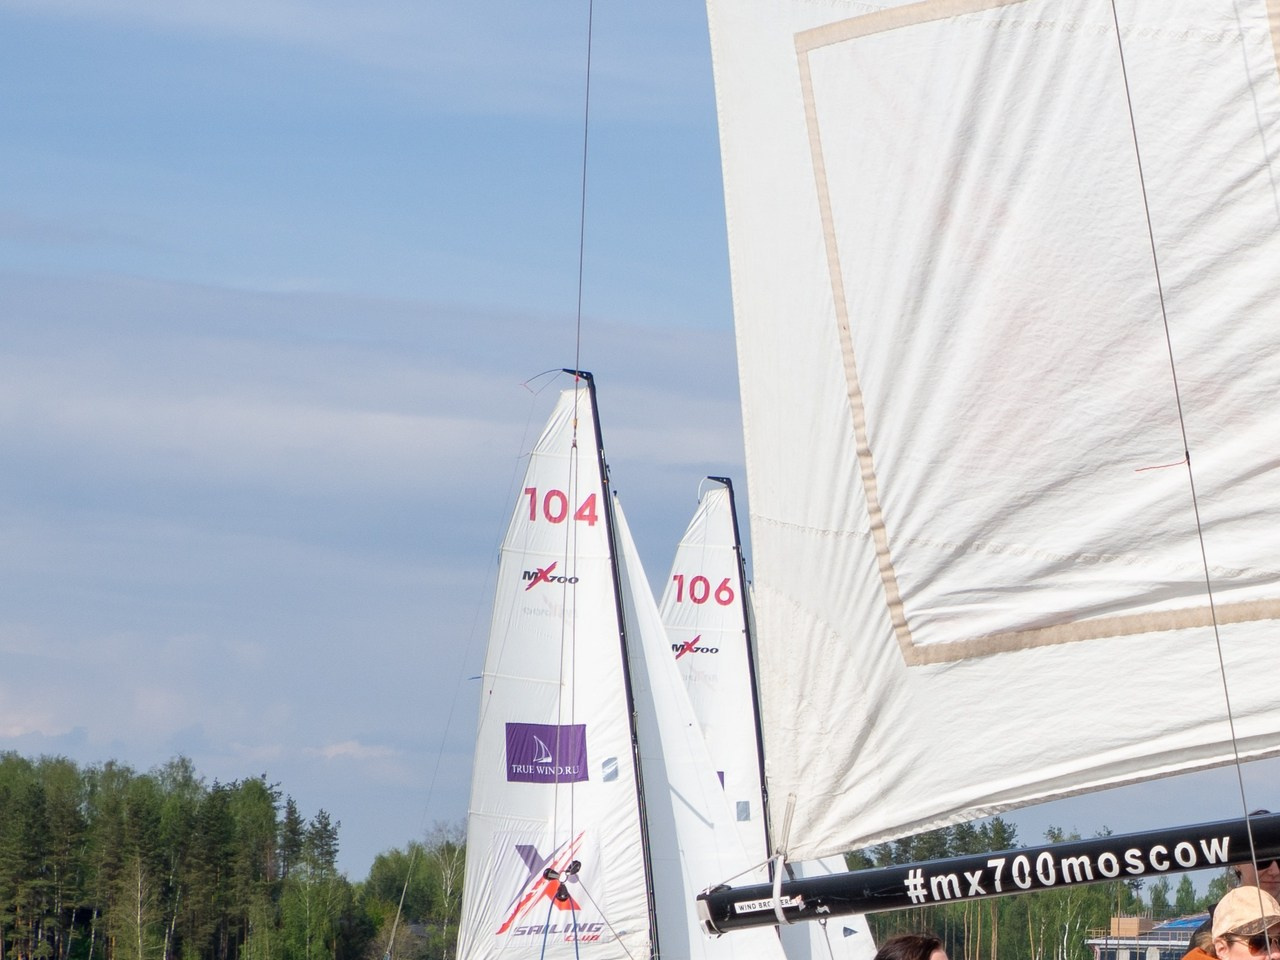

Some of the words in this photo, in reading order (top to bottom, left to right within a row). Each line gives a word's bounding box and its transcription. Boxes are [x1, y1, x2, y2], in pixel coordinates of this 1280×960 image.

[524, 487, 598, 527] 104
[672, 574, 735, 606] 106
[511, 764, 535, 774] TRUE
[536, 765, 580, 775] WIND.RU
[904, 836, 1230, 904] #mx700moscow
[738, 903, 757, 911] WIND
[514, 922, 605, 937] SAILING
[564, 934, 601, 942] CLUB
